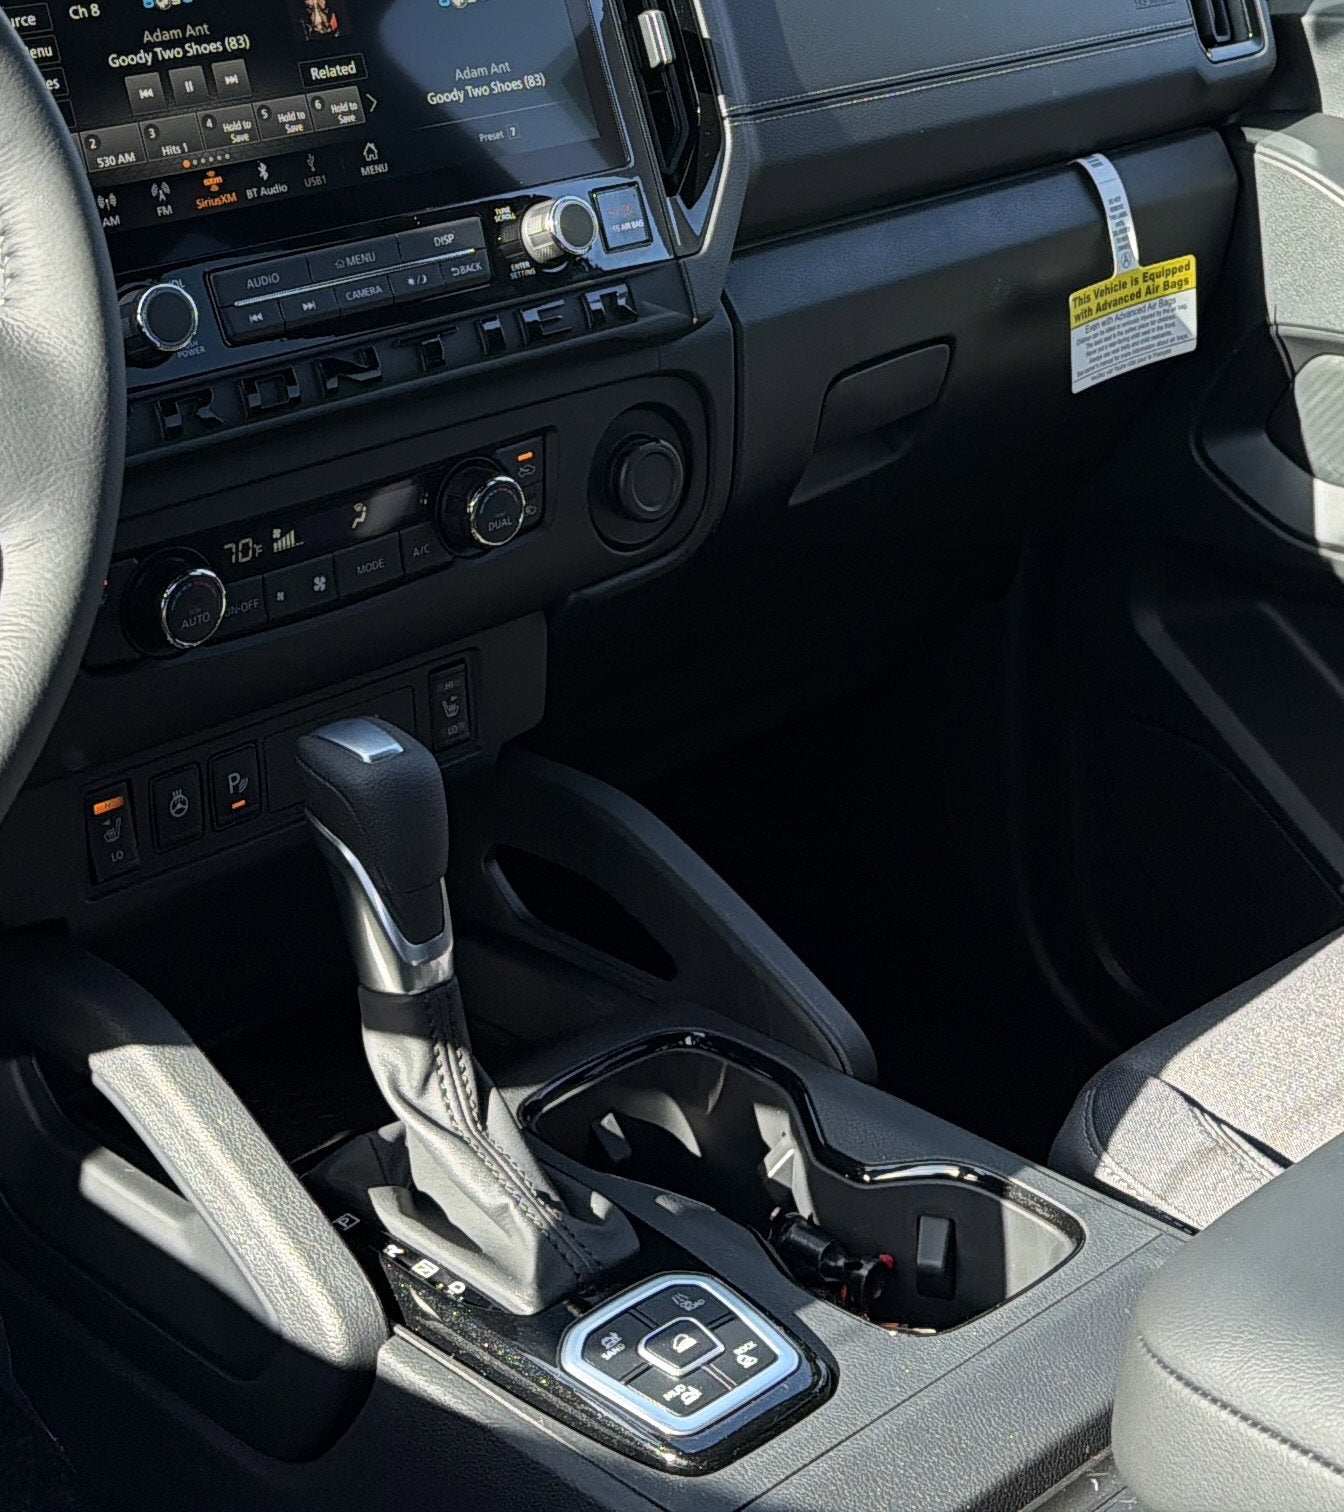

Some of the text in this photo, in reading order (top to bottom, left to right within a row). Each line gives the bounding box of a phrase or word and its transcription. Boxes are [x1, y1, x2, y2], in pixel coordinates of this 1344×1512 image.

[69, 3, 100, 19] Ch 8
[143, 24, 210, 44] Adam Ant
[109, 34, 250, 68] Goody Two Shoes (83)
[310, 60, 357, 80] Related
[455, 61, 511, 82] Adam Ant
[427, 73, 546, 105] Goody Two Shoes (83)
[314, 99, 322, 109] 6
[331, 102, 358, 114] Hold to
[261, 109, 268, 119] 5
[278, 111, 305, 123] Hold to
[338, 113, 356, 123] Save
[205, 118, 213, 129] 4
[223, 120, 251, 133] Hold to
[285, 123, 304, 133] Save
[148, 127, 156, 138] 3
[231, 133, 250, 143] Save
[479, 130, 504, 143] Preset
[89, 139, 98, 149] 2
[162, 143, 188, 156] Hits 1
[97, 152, 136, 167] 530 AM
[361, 163, 388, 176] MENU
[304, 174, 327, 187] USB1
[246, 183, 288, 199] BT Audio
[196, 192, 237, 209] SiriusXM
[157, 206, 172, 216] FM
[103, 215, 120, 227] AM
[621, 222, 631, 231] AIR
[632, 220, 644, 229] BAG
[433, 232, 455, 248] DISP
[345, 251, 376, 268] MENU
[459, 261, 483, 275] BACK
[246, 272, 280, 289] AUDIO
[1072, 261, 1190, 308] This Vehicle is Equipped
[345, 285, 384, 301] CAMERA
[1074, 277, 1189, 322] with Advanced Air Bags
[1115, 306, 1146, 322] Advanced
[1159, 298, 1176, 308] Bags
[177, 344, 206, 360] POWER
[154, 284, 641, 441] RONTIER
[488, 516, 513, 532] DUAL
[412, 543, 431, 559] A/C
[356, 559, 386, 577] MODE
[180, 611, 211, 631] AUTO
[110, 849, 124, 863] LO
[600, 1342, 626, 1361] SAND
[662, 1384, 686, 1401] MUD
